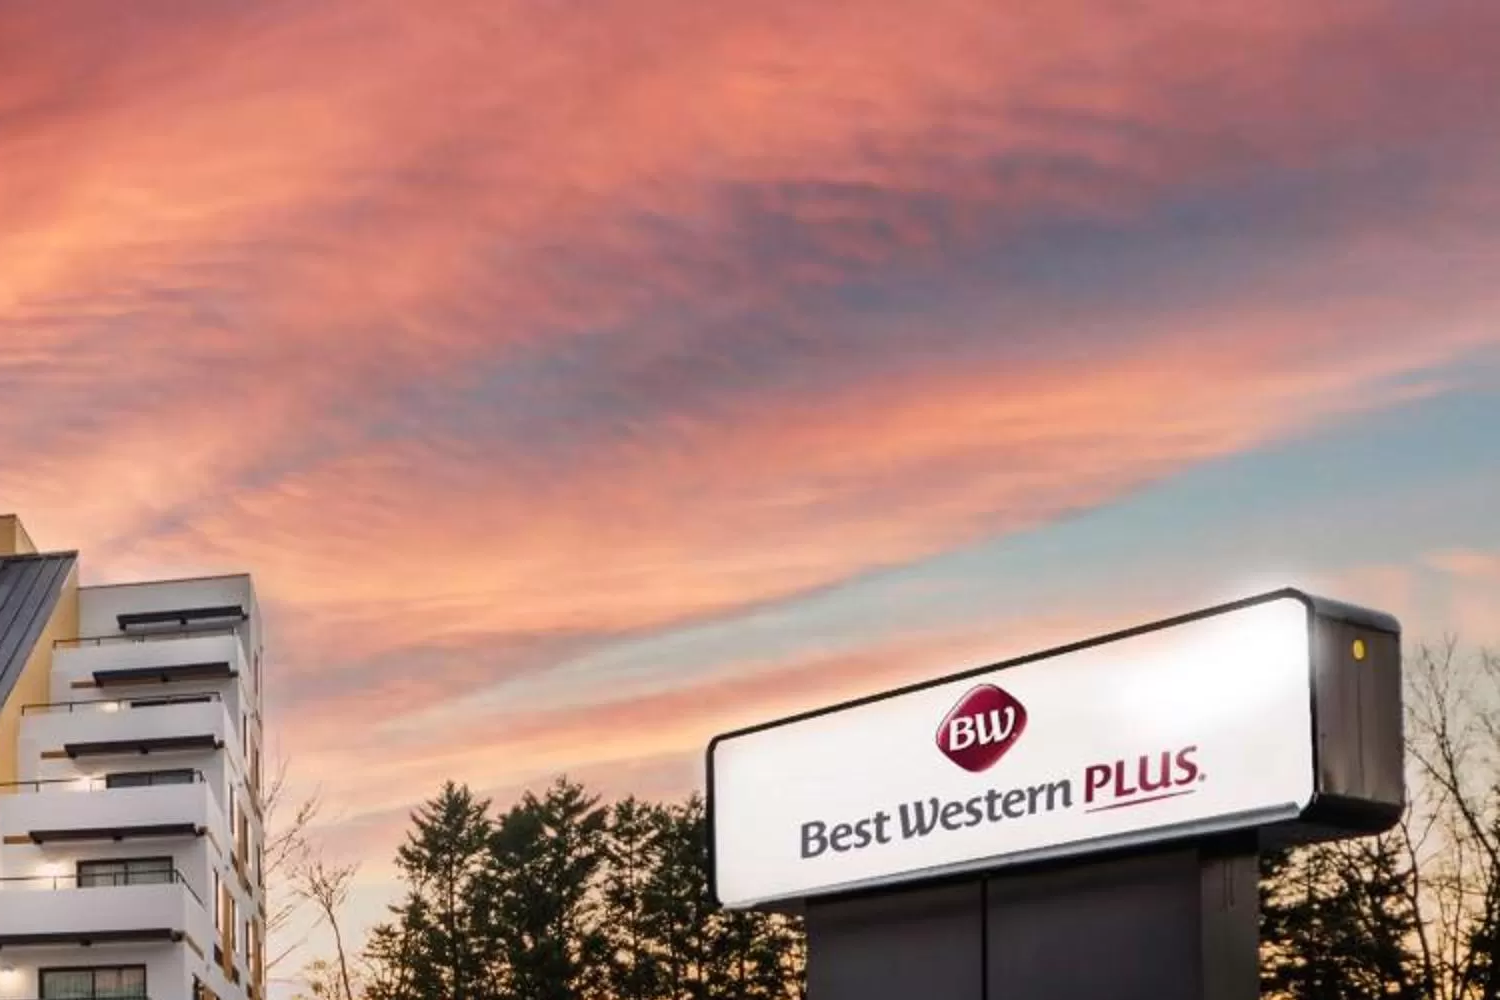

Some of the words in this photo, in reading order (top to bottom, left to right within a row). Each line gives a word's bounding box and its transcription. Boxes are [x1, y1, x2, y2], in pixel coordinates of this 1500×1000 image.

[949, 705, 1015, 752] BW
[800, 811, 892, 859] Best
[899, 779, 1072, 840] Western
[1084, 745, 1199, 803] PLUS
